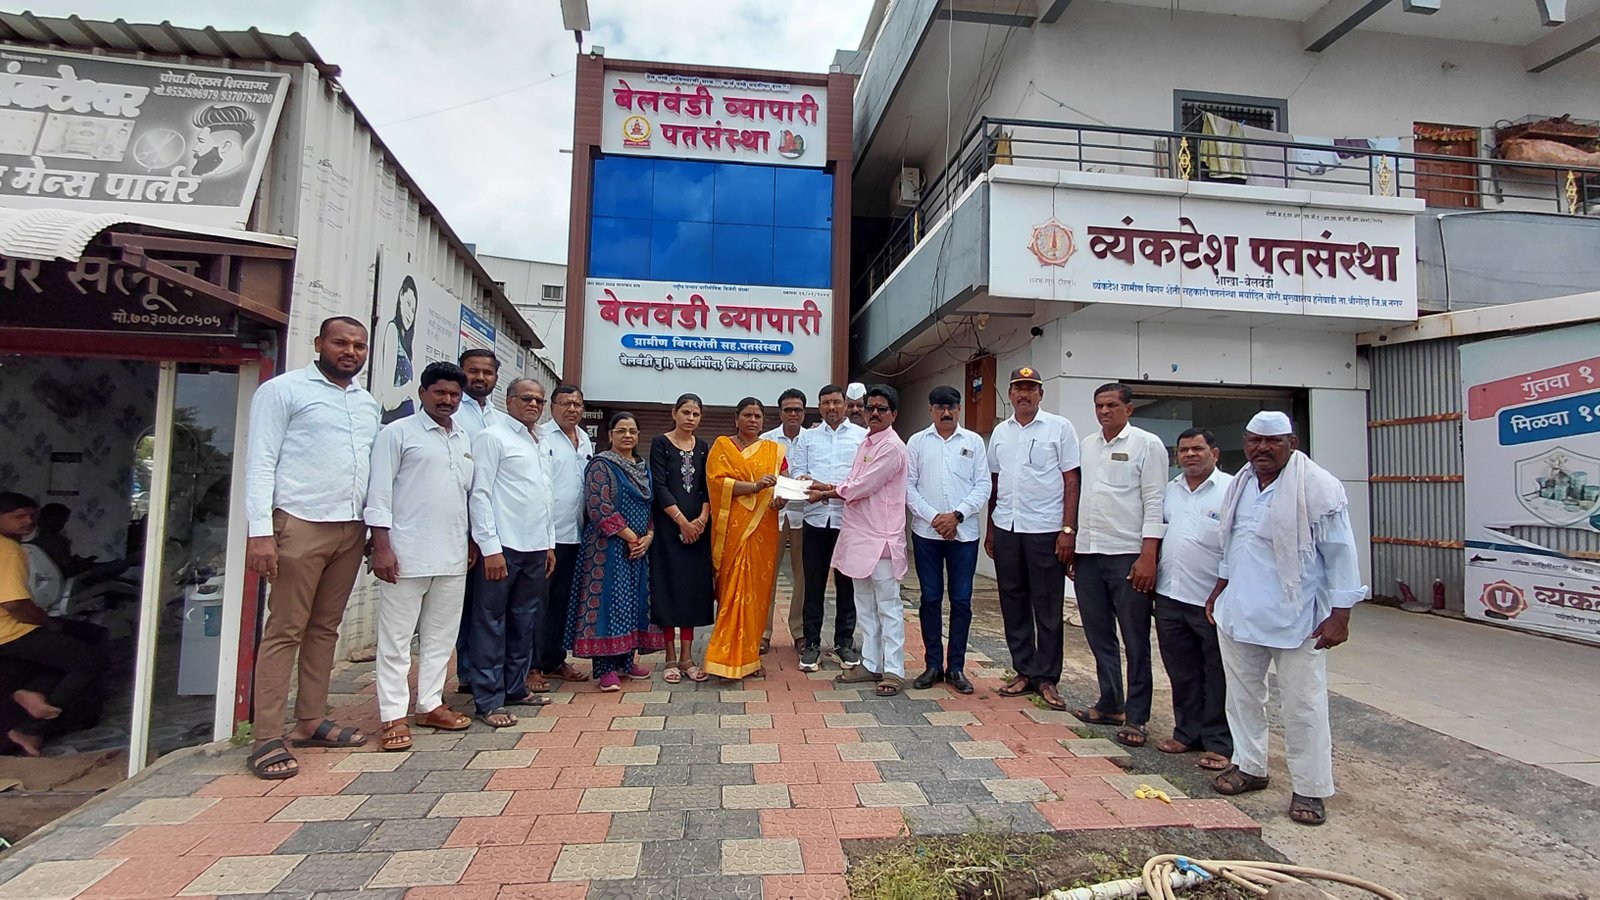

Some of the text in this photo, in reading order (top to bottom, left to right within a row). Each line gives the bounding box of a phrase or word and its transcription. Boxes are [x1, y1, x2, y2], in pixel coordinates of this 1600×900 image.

[0, 60, 151, 118] ंकटेश्वर
[612, 79, 819, 126] बेलवंडी व्यापारी
[660, 120, 771, 153] पतसंस्था
[11, 155, 100, 198] मेन्स
[104, 166, 202, 203] पार्लर
[1088, 215, 1400, 282] व्यंकटेश पतसंस्था
[1120, 282, 1143, 293] ग्रामीण
[1182, 286, 1208, 297] सहकारी
[1215, 274, 1274, 289] शाखा-बेलवंडी
[597, 288, 822, 336] बेलवंडी व्यापारी
[633, 336, 668, 347] ग्रामीण
[672, 336, 718, 349] बिगरशेती
[619, 353, 653, 368] बेलवंडी
[1521, 373, 1570, 400] गुंतवा
[1510, 411, 1569, 434] मिळवा
